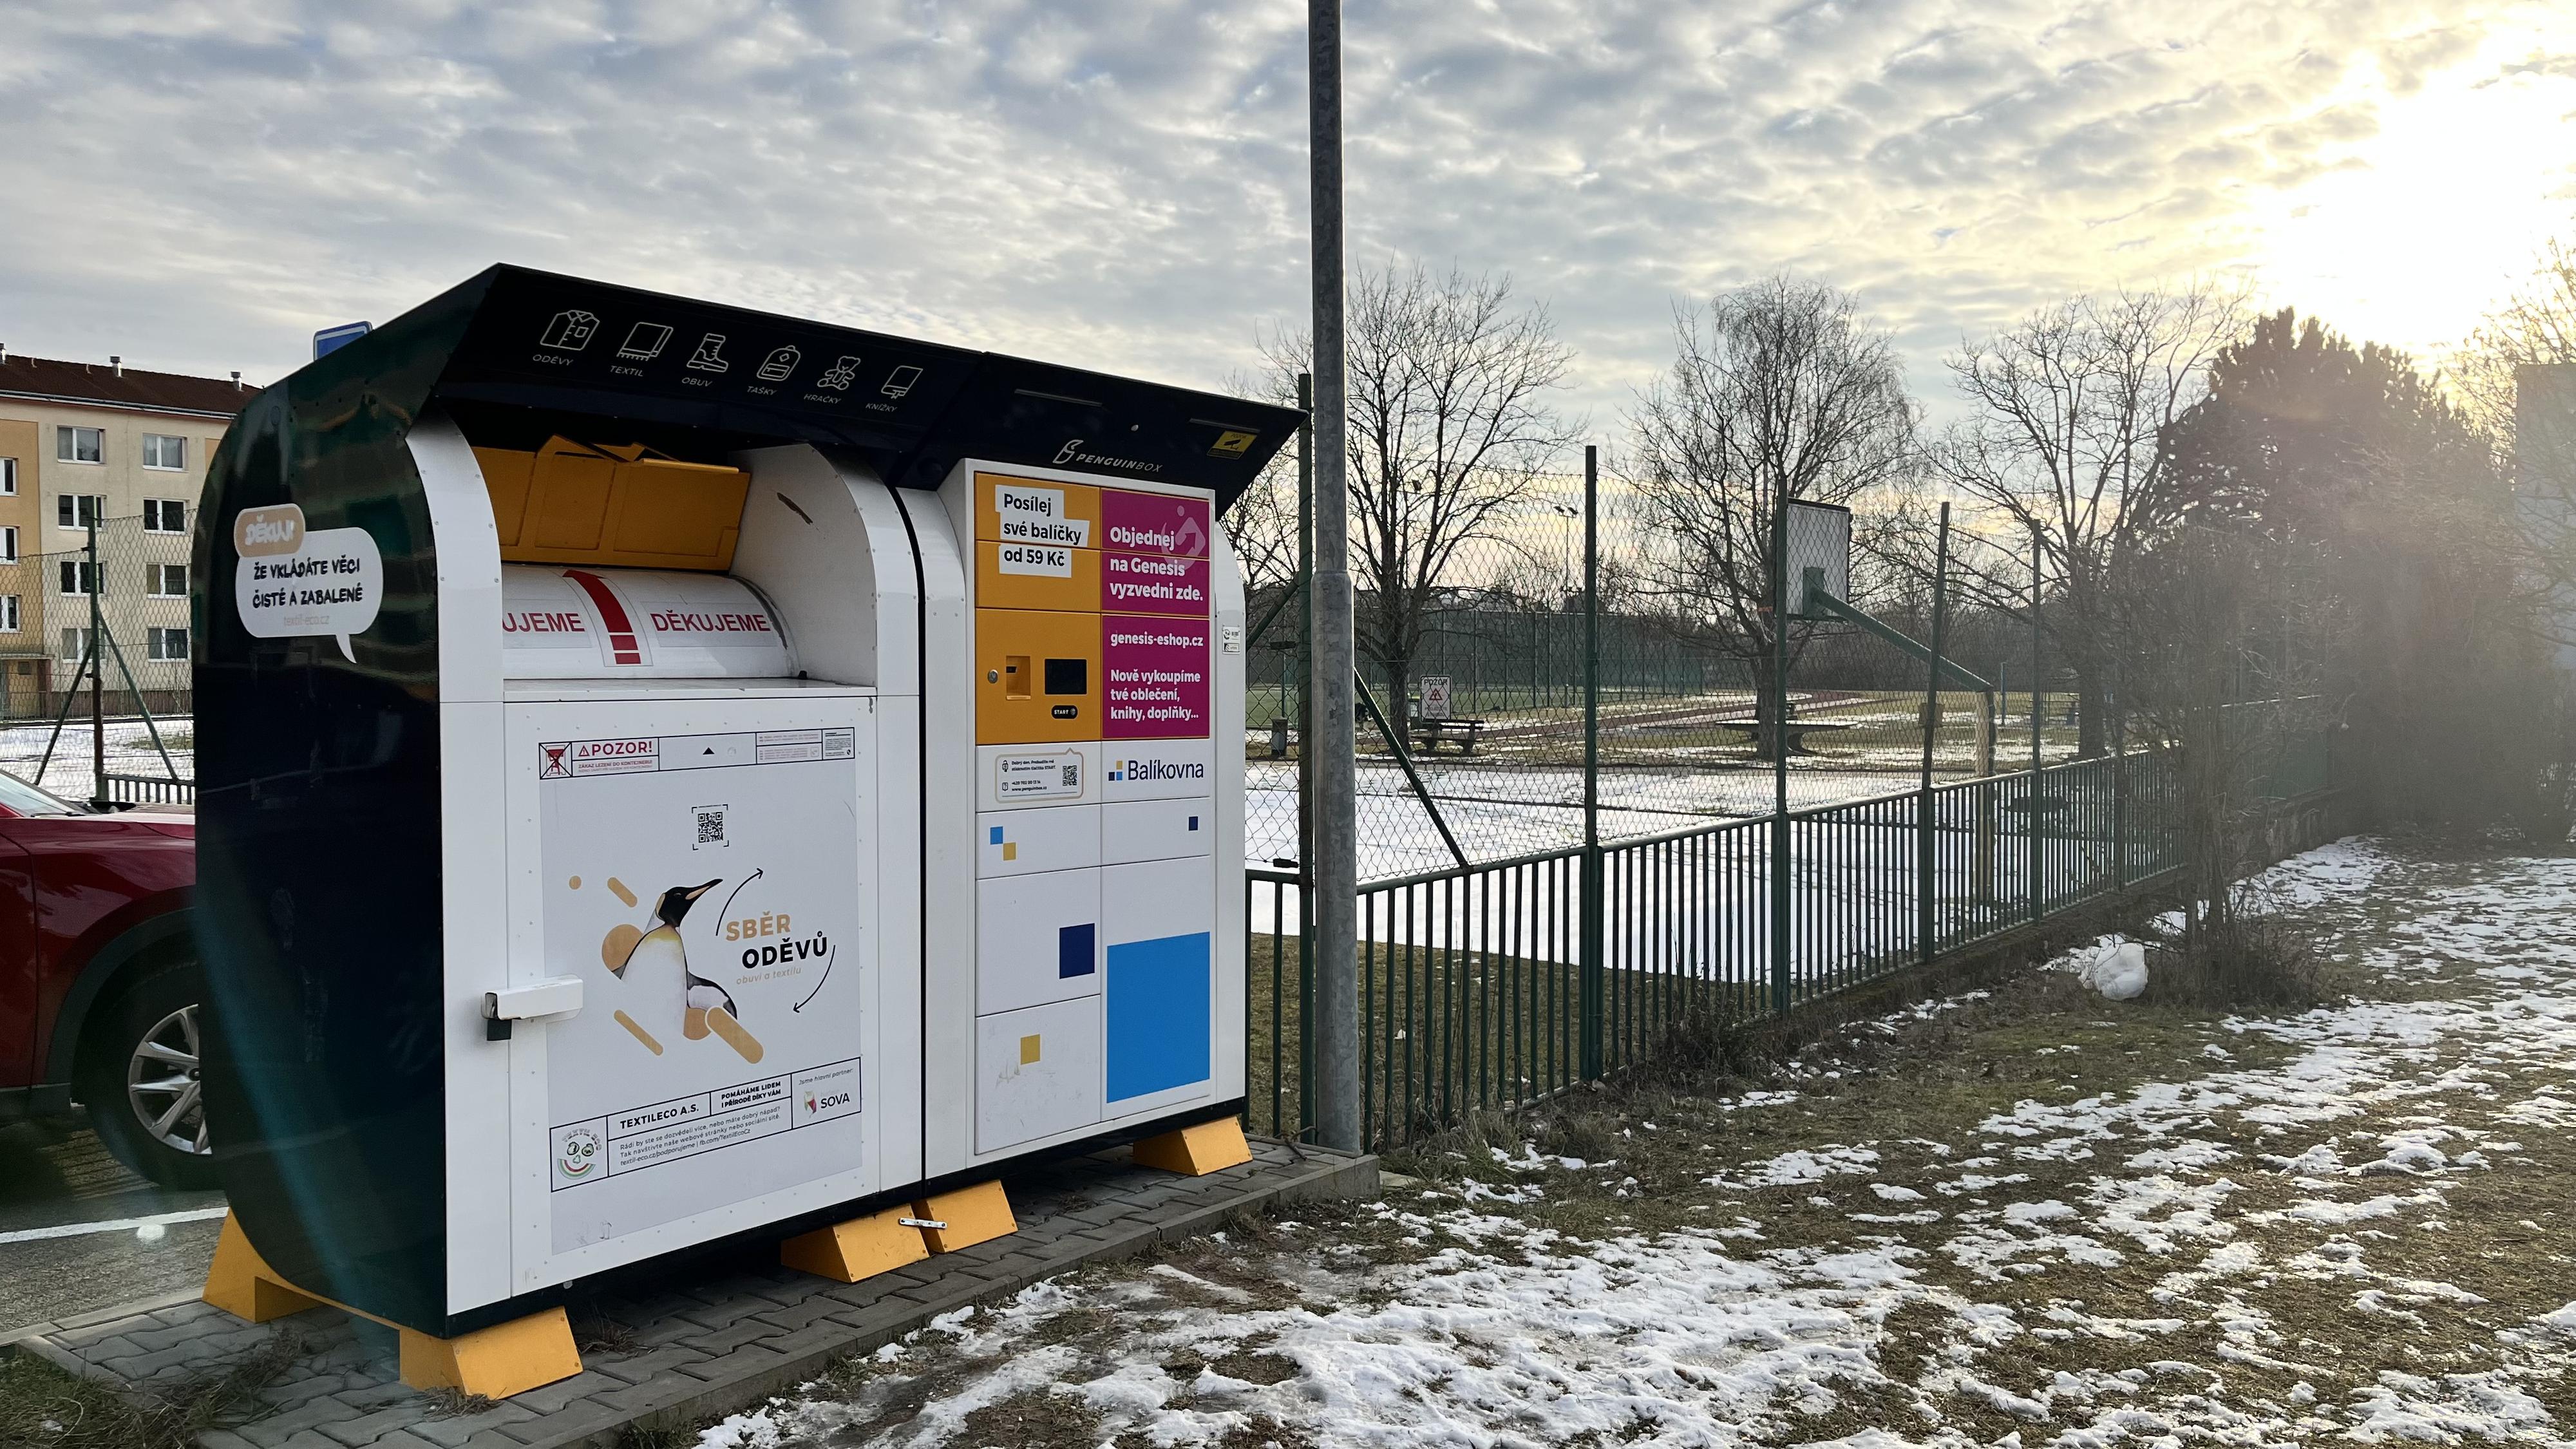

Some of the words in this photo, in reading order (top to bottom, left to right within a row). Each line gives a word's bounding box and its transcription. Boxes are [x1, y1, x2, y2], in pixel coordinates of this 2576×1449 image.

[532, 352, 574, 366] ODĚVY
[609, 365, 644, 377] TEXTIL
[681, 376, 712, 387] OBUV
[746, 384, 777, 396] TAŠKY
[803, 393, 841, 405] HRAČKY
[865, 402, 897, 413] KNÍŽKY
[1075, 453, 1162, 473] PENGUINBOX
[1003, 493, 1052, 516] Posílej
[1003, 522, 1028, 536] své
[1031, 523, 1082, 543] balíčky
[1110, 527, 1175, 548] Objednej
[1004, 547, 1023, 564] od
[1026, 549, 1044, 565] 59
[1048, 550, 1065, 567] Kč
[254, 561, 267, 580] ŽE
[270, 556, 328, 579] VKLÁDÁTE
[332, 554, 360, 574] VĚCI
[1110, 558, 1128, 573] na
[1132, 558, 1186, 576] Genesis
[252, 587, 286, 609] ČISTÉ
[289, 589, 298, 607] A
[300, 582, 363, 605] ZABALENÉ
[1110, 582, 1173, 600] vyzvedni
[1176, 585, 1204, 601] zde.
[650, 609, 772, 632] DĚKUJEME
[1110, 630, 1204, 650] genesis-eshop.cz
[1110, 669, 1139, 683] Nově
[1141, 672, 1201, 687] vykoupíme
[1110, 688, 1129, 701] tvé
[1131, 688, 1180, 703] oblečení,
[1110, 706, 1146, 722] knihy,
[591, 741, 652, 756] POZOR!
[1128, 760, 1204, 781] Balíkovna
[726, 911, 791, 942] SBĚR
[742, 931, 828, 969] ODĚVŮ
[736, 972, 761, 985] obuvi
[773, 967, 802, 978] textilu
[721, 1086, 759, 1099] POMÁHÁME
[761, 1081, 781, 1090] LIDEM
[724, 1096, 751, 1108] PŘÍRODĚ
[752, 1092, 766, 1101] DÍKY
[820, 1093, 850, 1109] SOVA
[620, 1108, 677, 1129] TEXTILECO
[680, 1104, 699, 1115] A.S.
